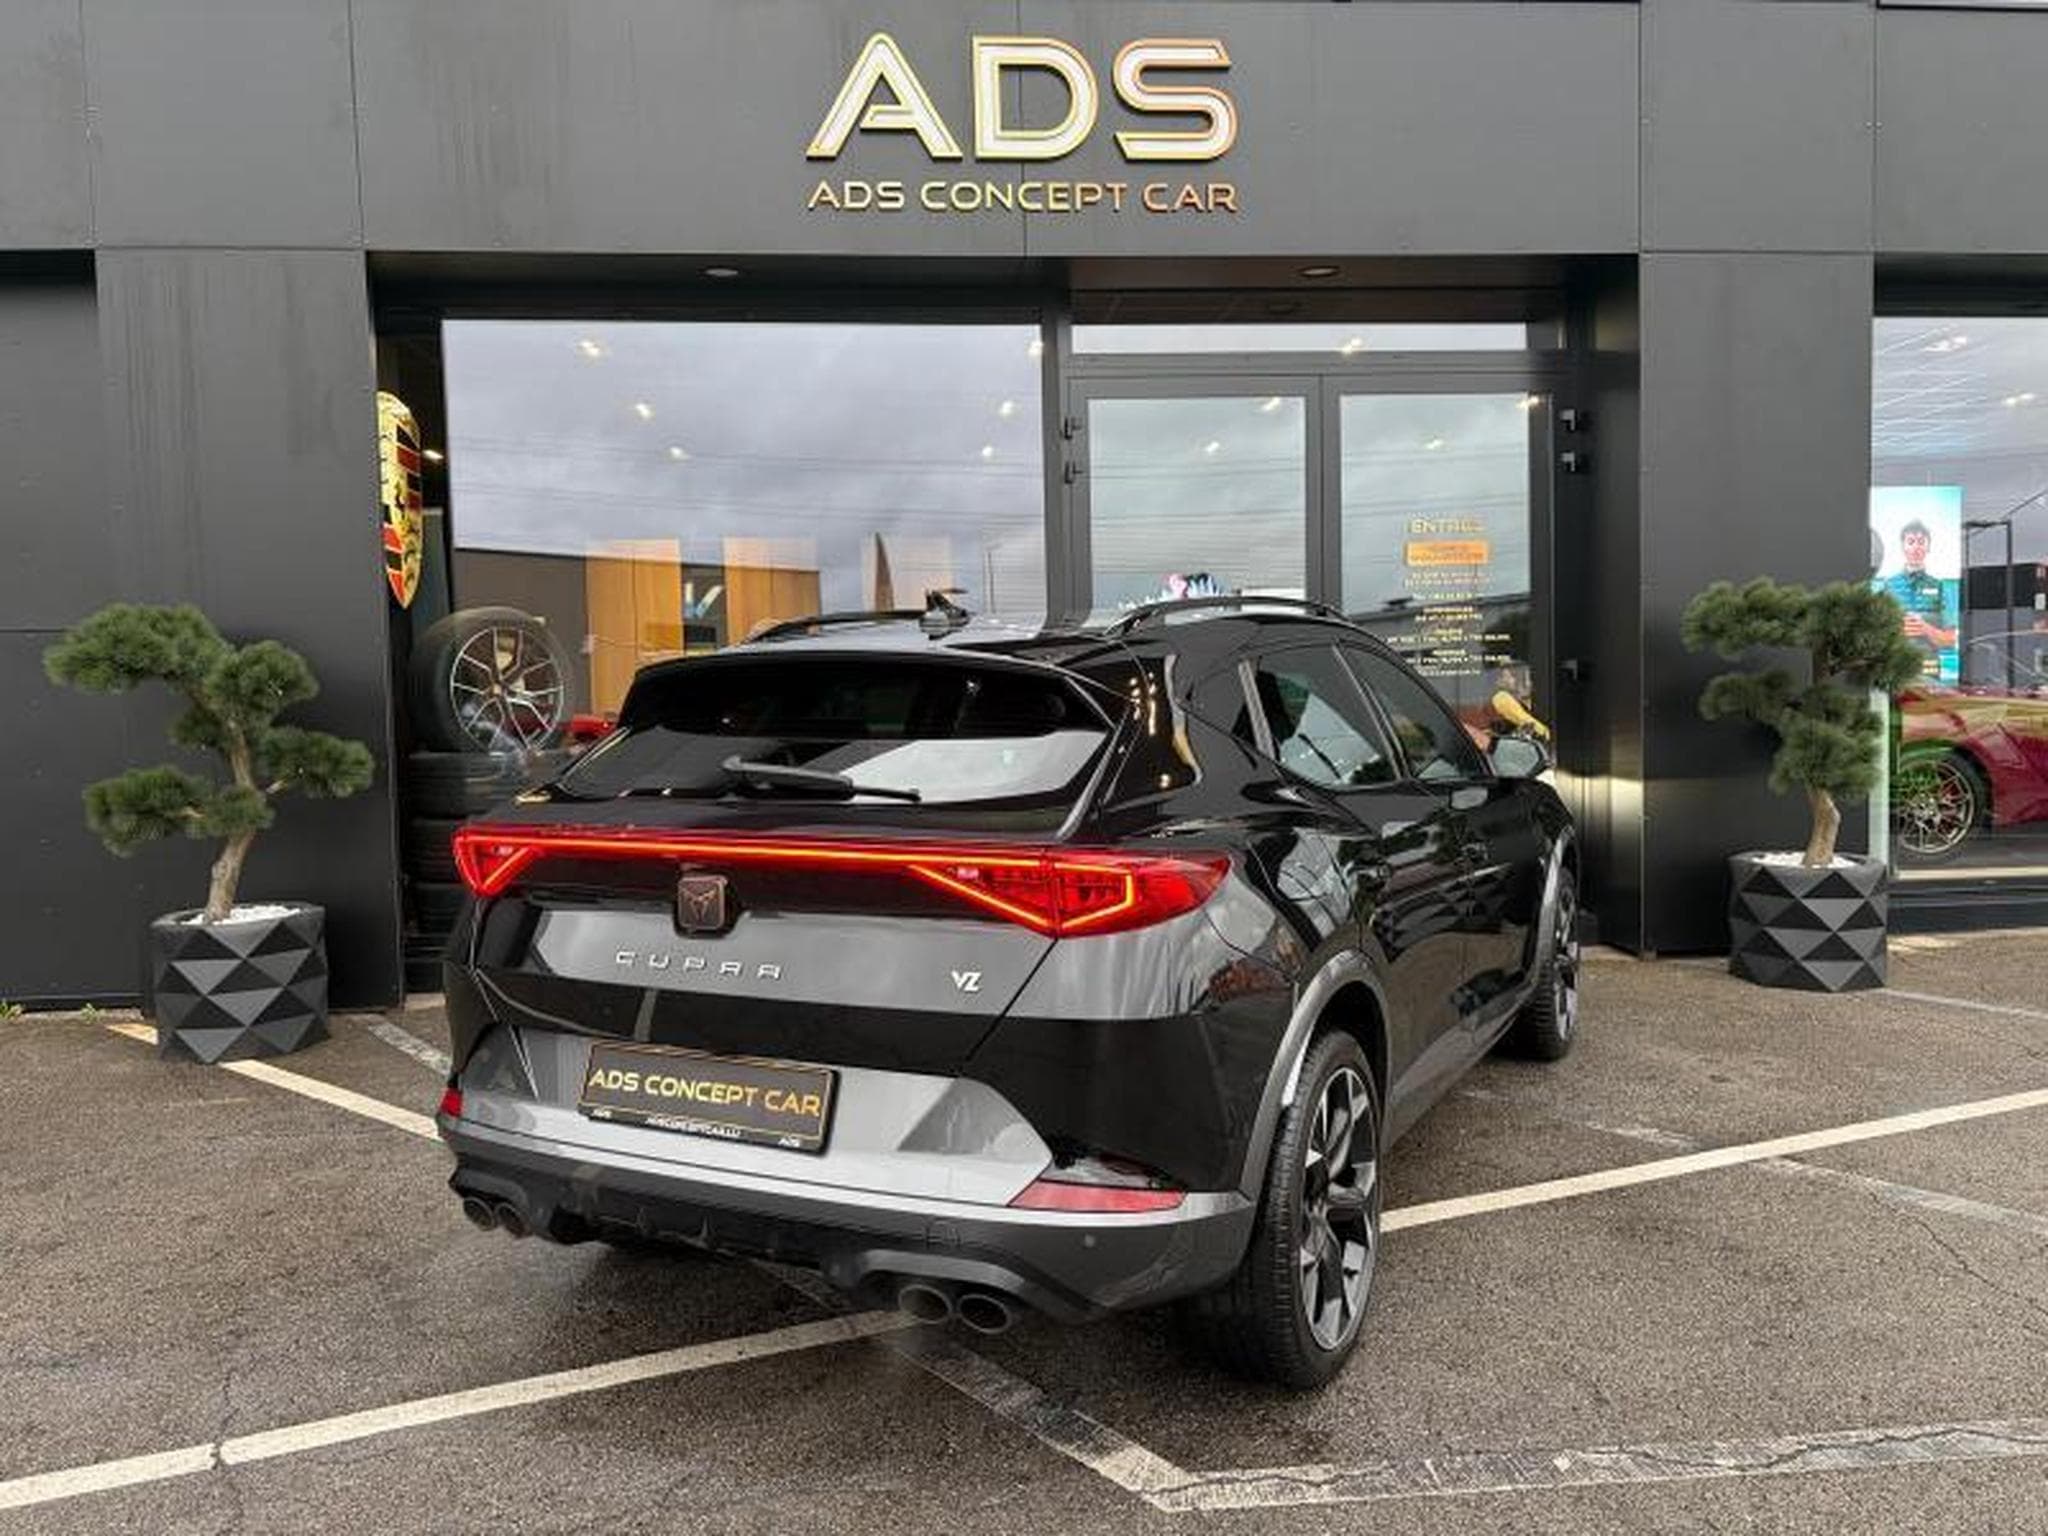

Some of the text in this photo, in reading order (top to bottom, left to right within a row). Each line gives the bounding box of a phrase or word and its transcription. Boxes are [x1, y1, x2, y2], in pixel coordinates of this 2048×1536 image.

[806, 32, 1238, 161] ADS
[808, 181, 1238, 213] ADS CONCEPT CAR
[615, 951, 783, 981] CUPRA
[950, 970, 983, 993] VZ
[589, 1067, 822, 1117] ADS CONCEPT CAR
